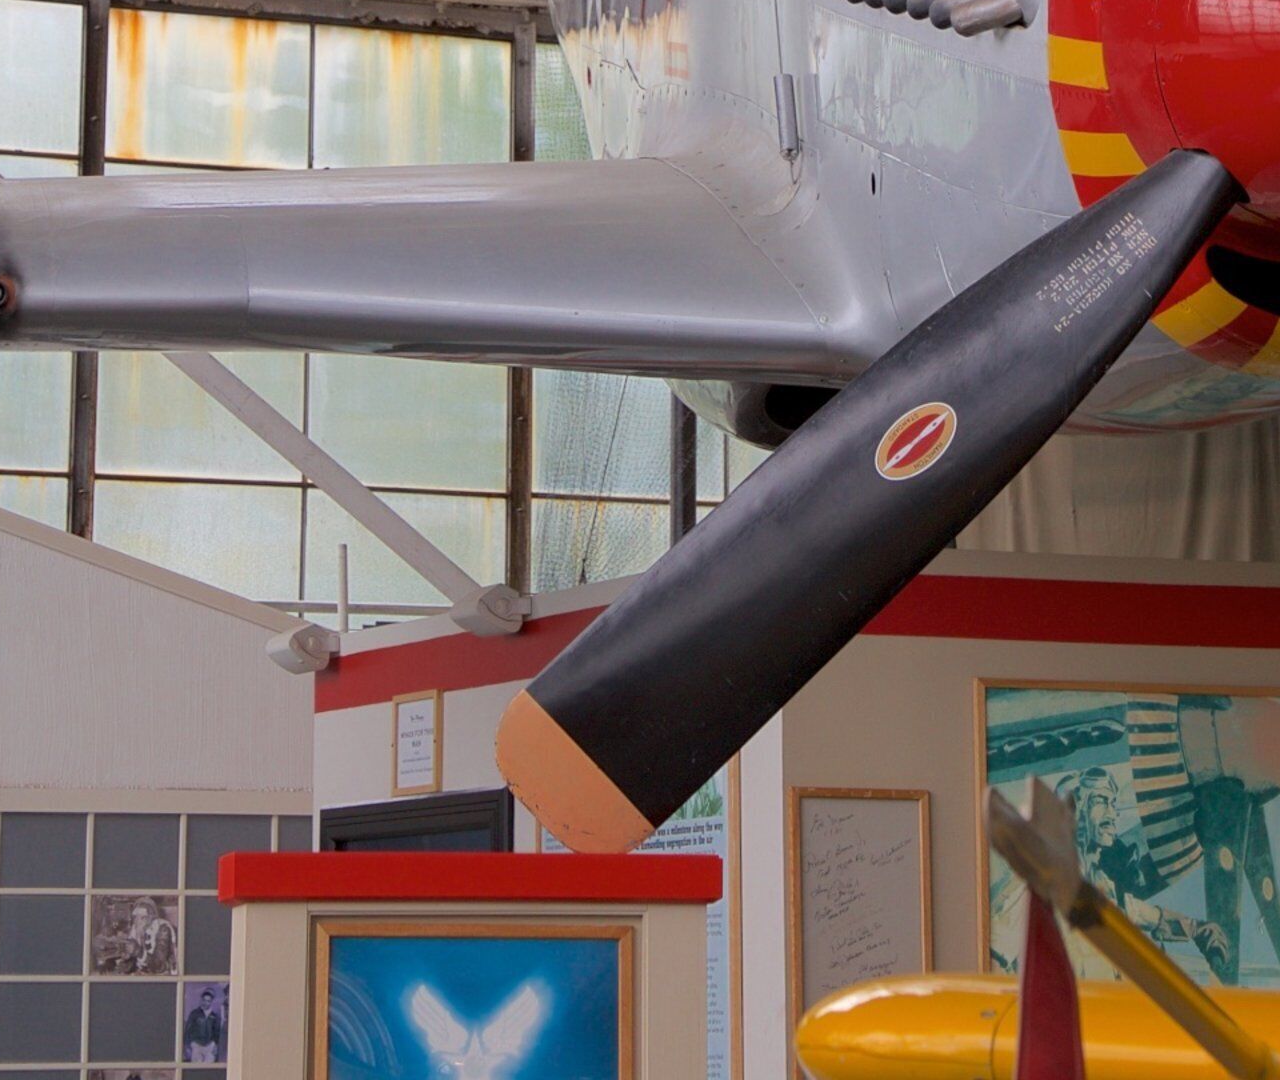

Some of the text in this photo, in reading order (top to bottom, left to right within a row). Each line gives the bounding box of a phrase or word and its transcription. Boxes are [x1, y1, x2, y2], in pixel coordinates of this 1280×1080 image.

[1105, 211, 1134, 239] HIGH
[1126, 229, 1148, 249] SER
[1067, 240, 1102, 272] PITCH
[1082, 241, 1117, 274] PITCH
[1050, 275, 1078, 302] 23.2
